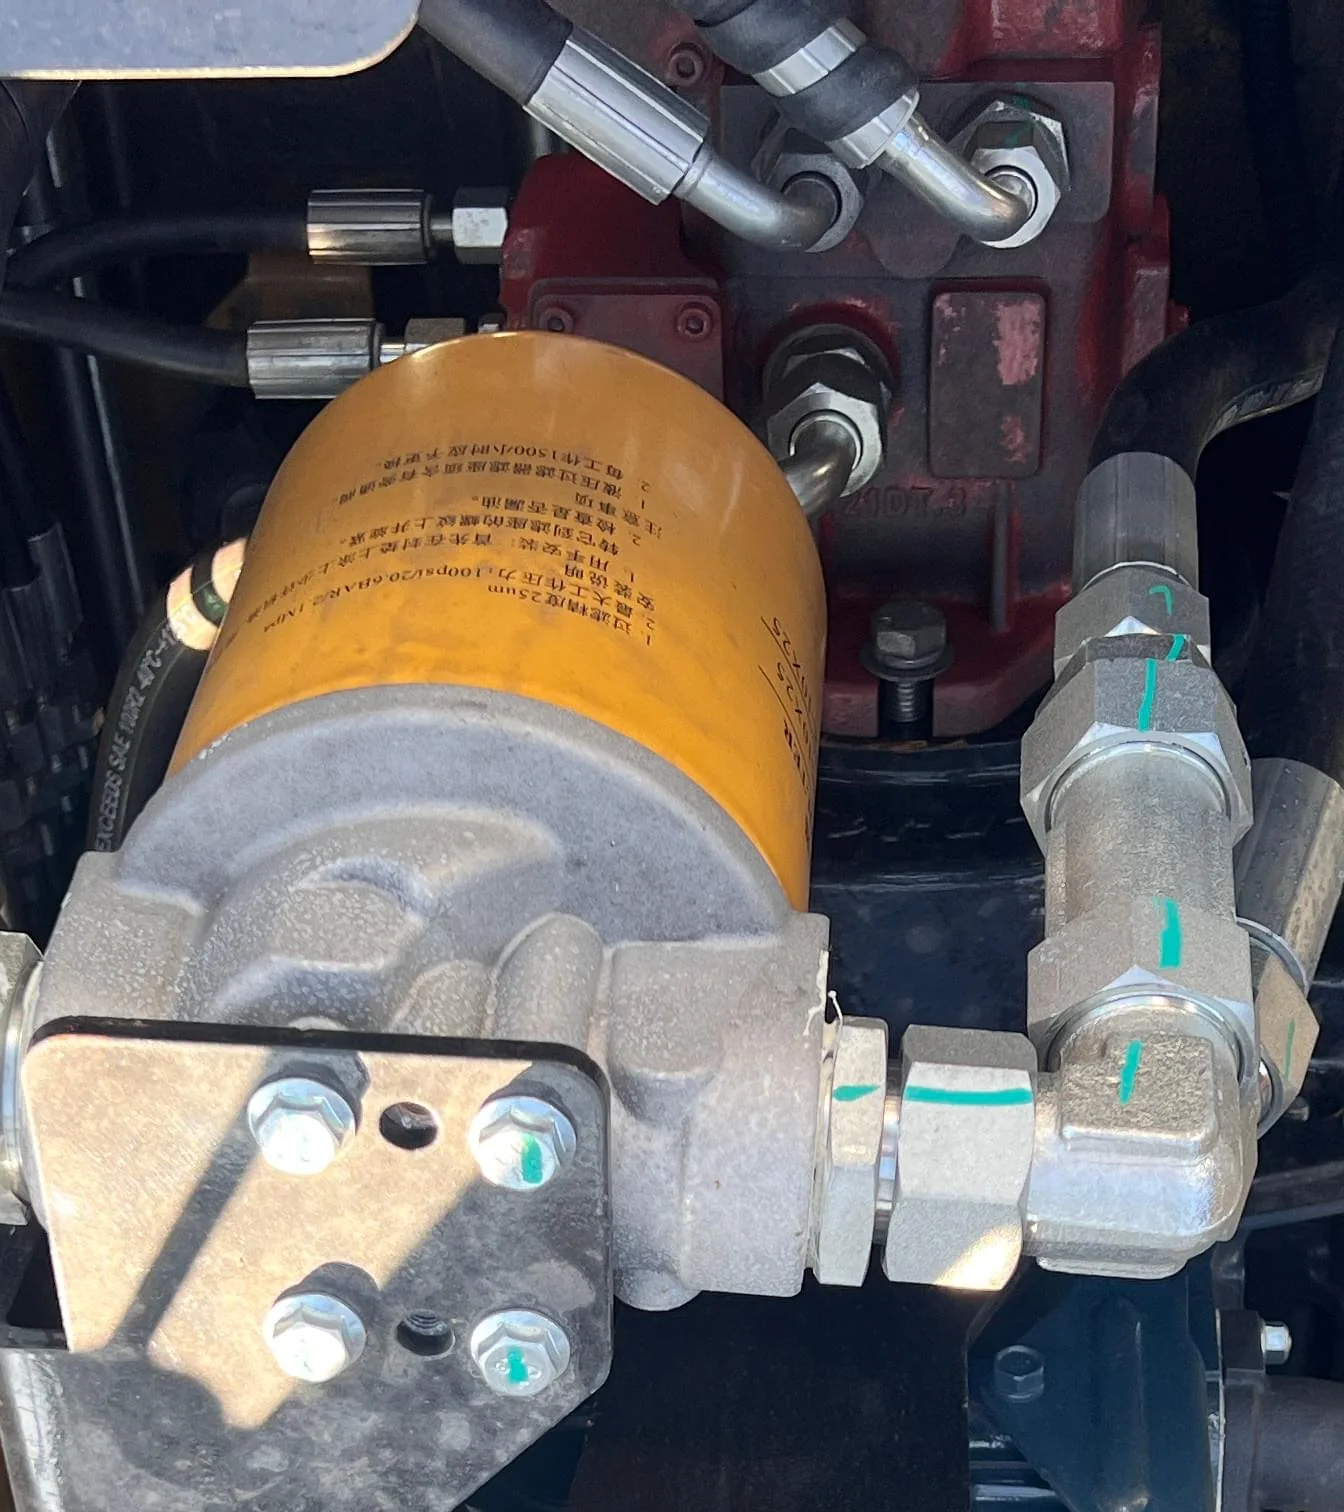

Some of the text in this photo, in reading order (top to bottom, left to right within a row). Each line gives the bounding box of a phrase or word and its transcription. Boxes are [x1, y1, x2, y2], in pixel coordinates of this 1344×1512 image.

[563, 563, 656, 613] 安装说明
[108, 732, 132, 772] SAE
